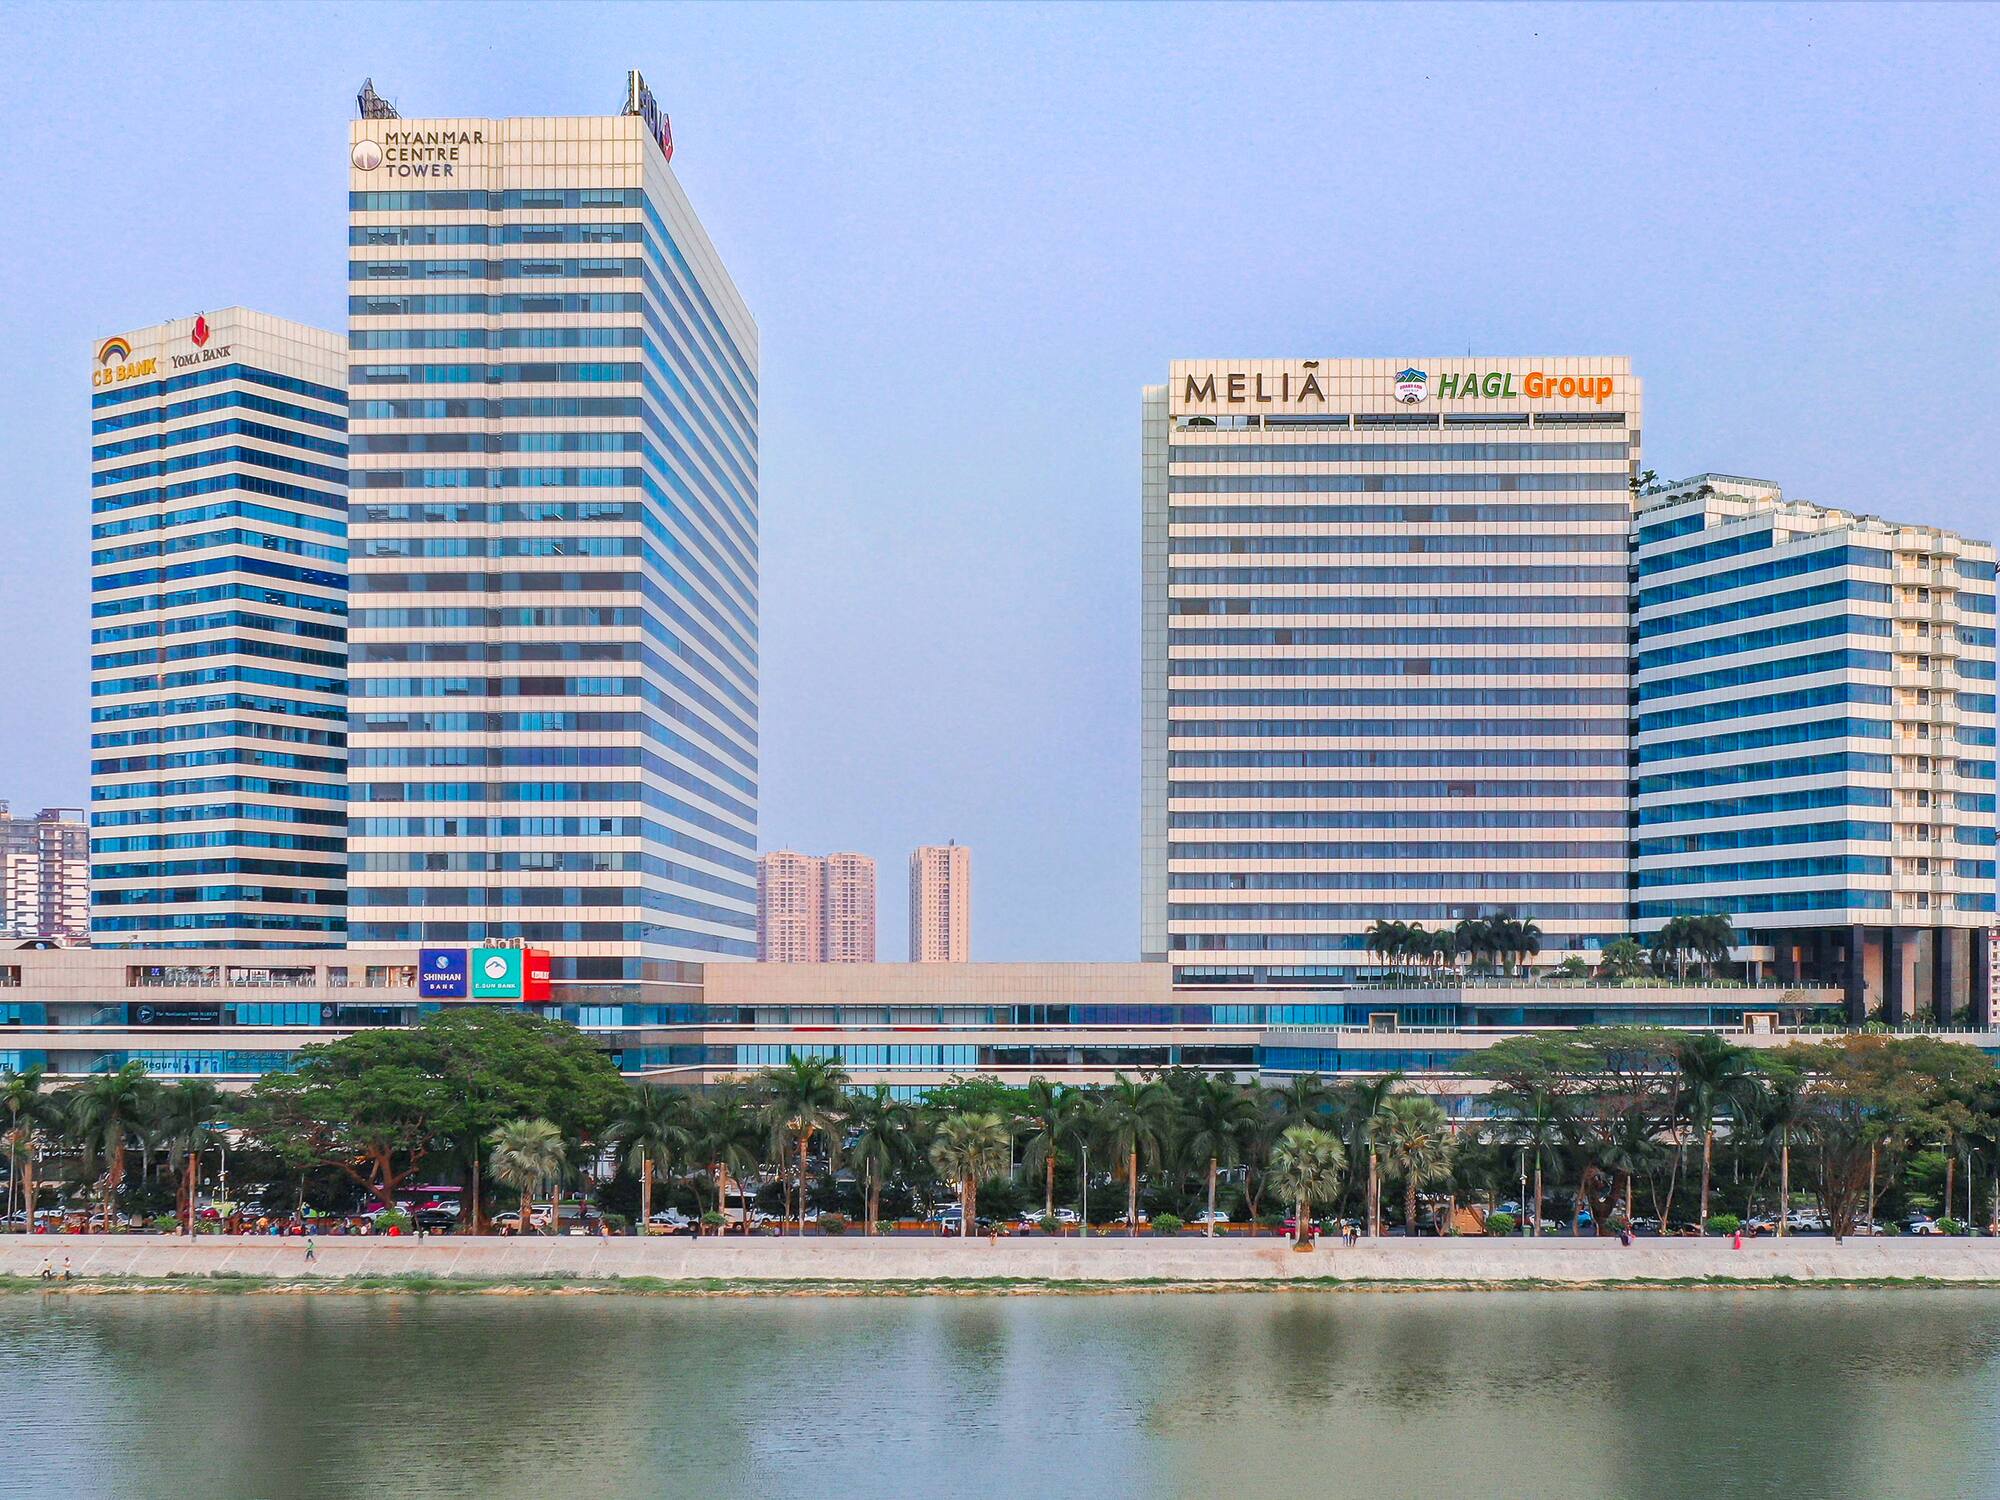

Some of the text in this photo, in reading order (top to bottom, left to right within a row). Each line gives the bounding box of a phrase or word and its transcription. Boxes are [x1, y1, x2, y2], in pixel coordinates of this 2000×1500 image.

[385, 131, 484, 145] MYANMAR
[385, 147, 459, 161] CENTRE
[386, 164, 454, 177] TOWER
[171, 345, 231, 369] YOMA BANK
[116, 357, 157, 382] BANK
[1184, 360, 1326, 403] MELIÃ
[1437, 371, 1614, 404] HAGL Group
[423, 973, 462, 981] SHINHAN
